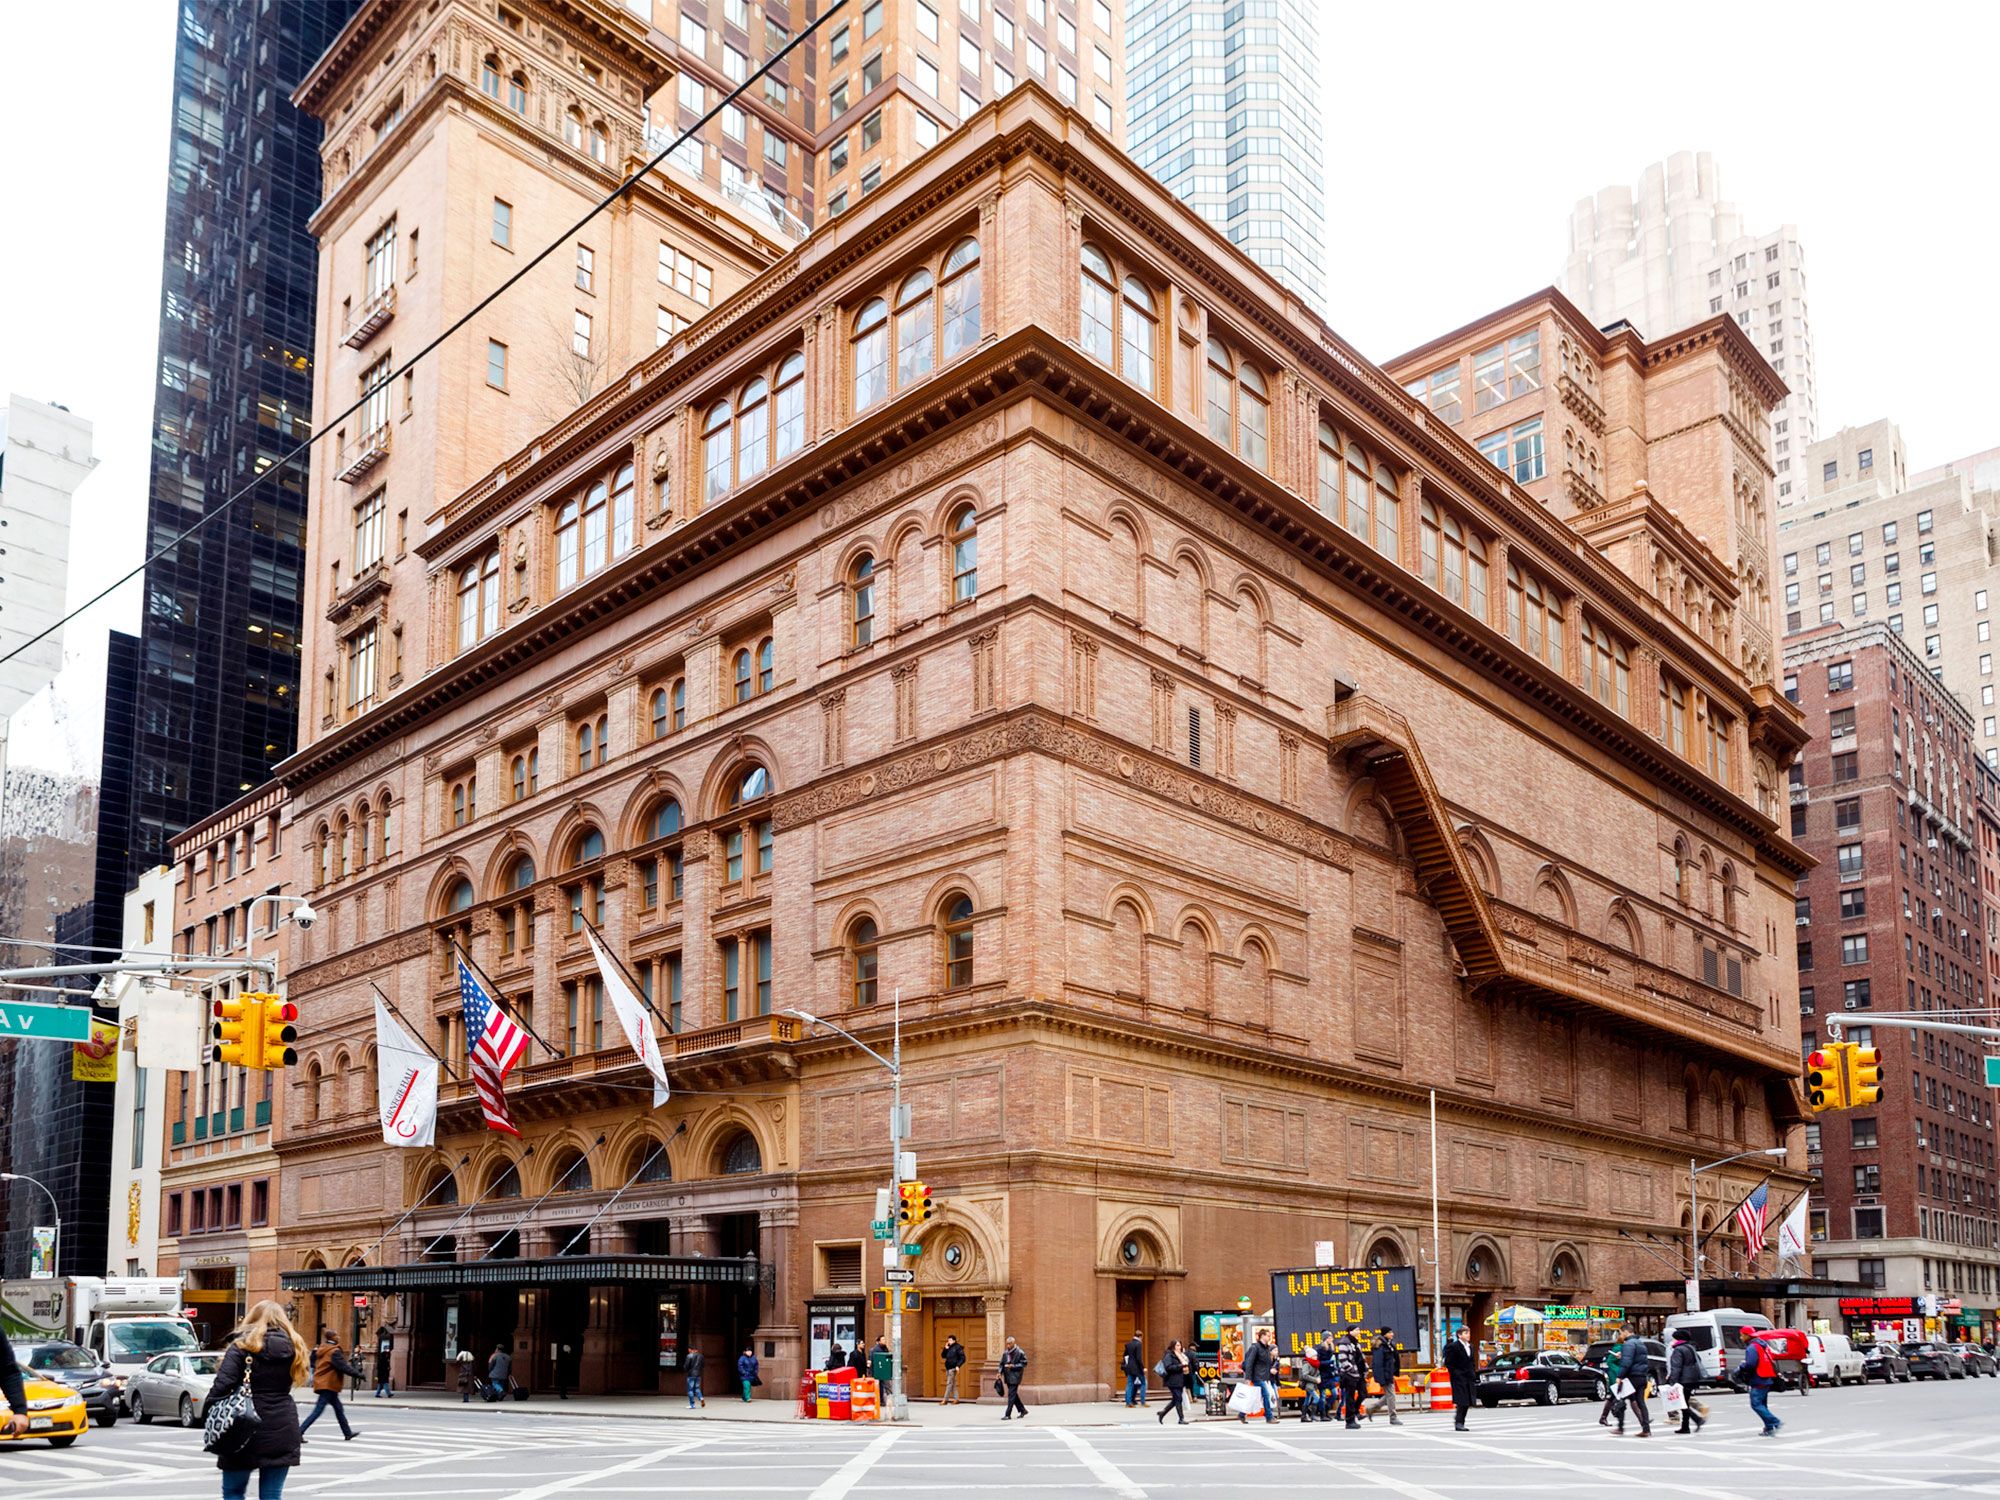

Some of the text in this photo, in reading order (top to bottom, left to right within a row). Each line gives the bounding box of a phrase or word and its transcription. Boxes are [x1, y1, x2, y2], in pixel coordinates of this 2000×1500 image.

[0, 1008, 33, 1029] Av
[383, 1067, 416, 1126] CARNEGIE HALL
[641, 1199, 670, 1209] CARNEGIE
[1324, 1301, 1364, 1324] TO
